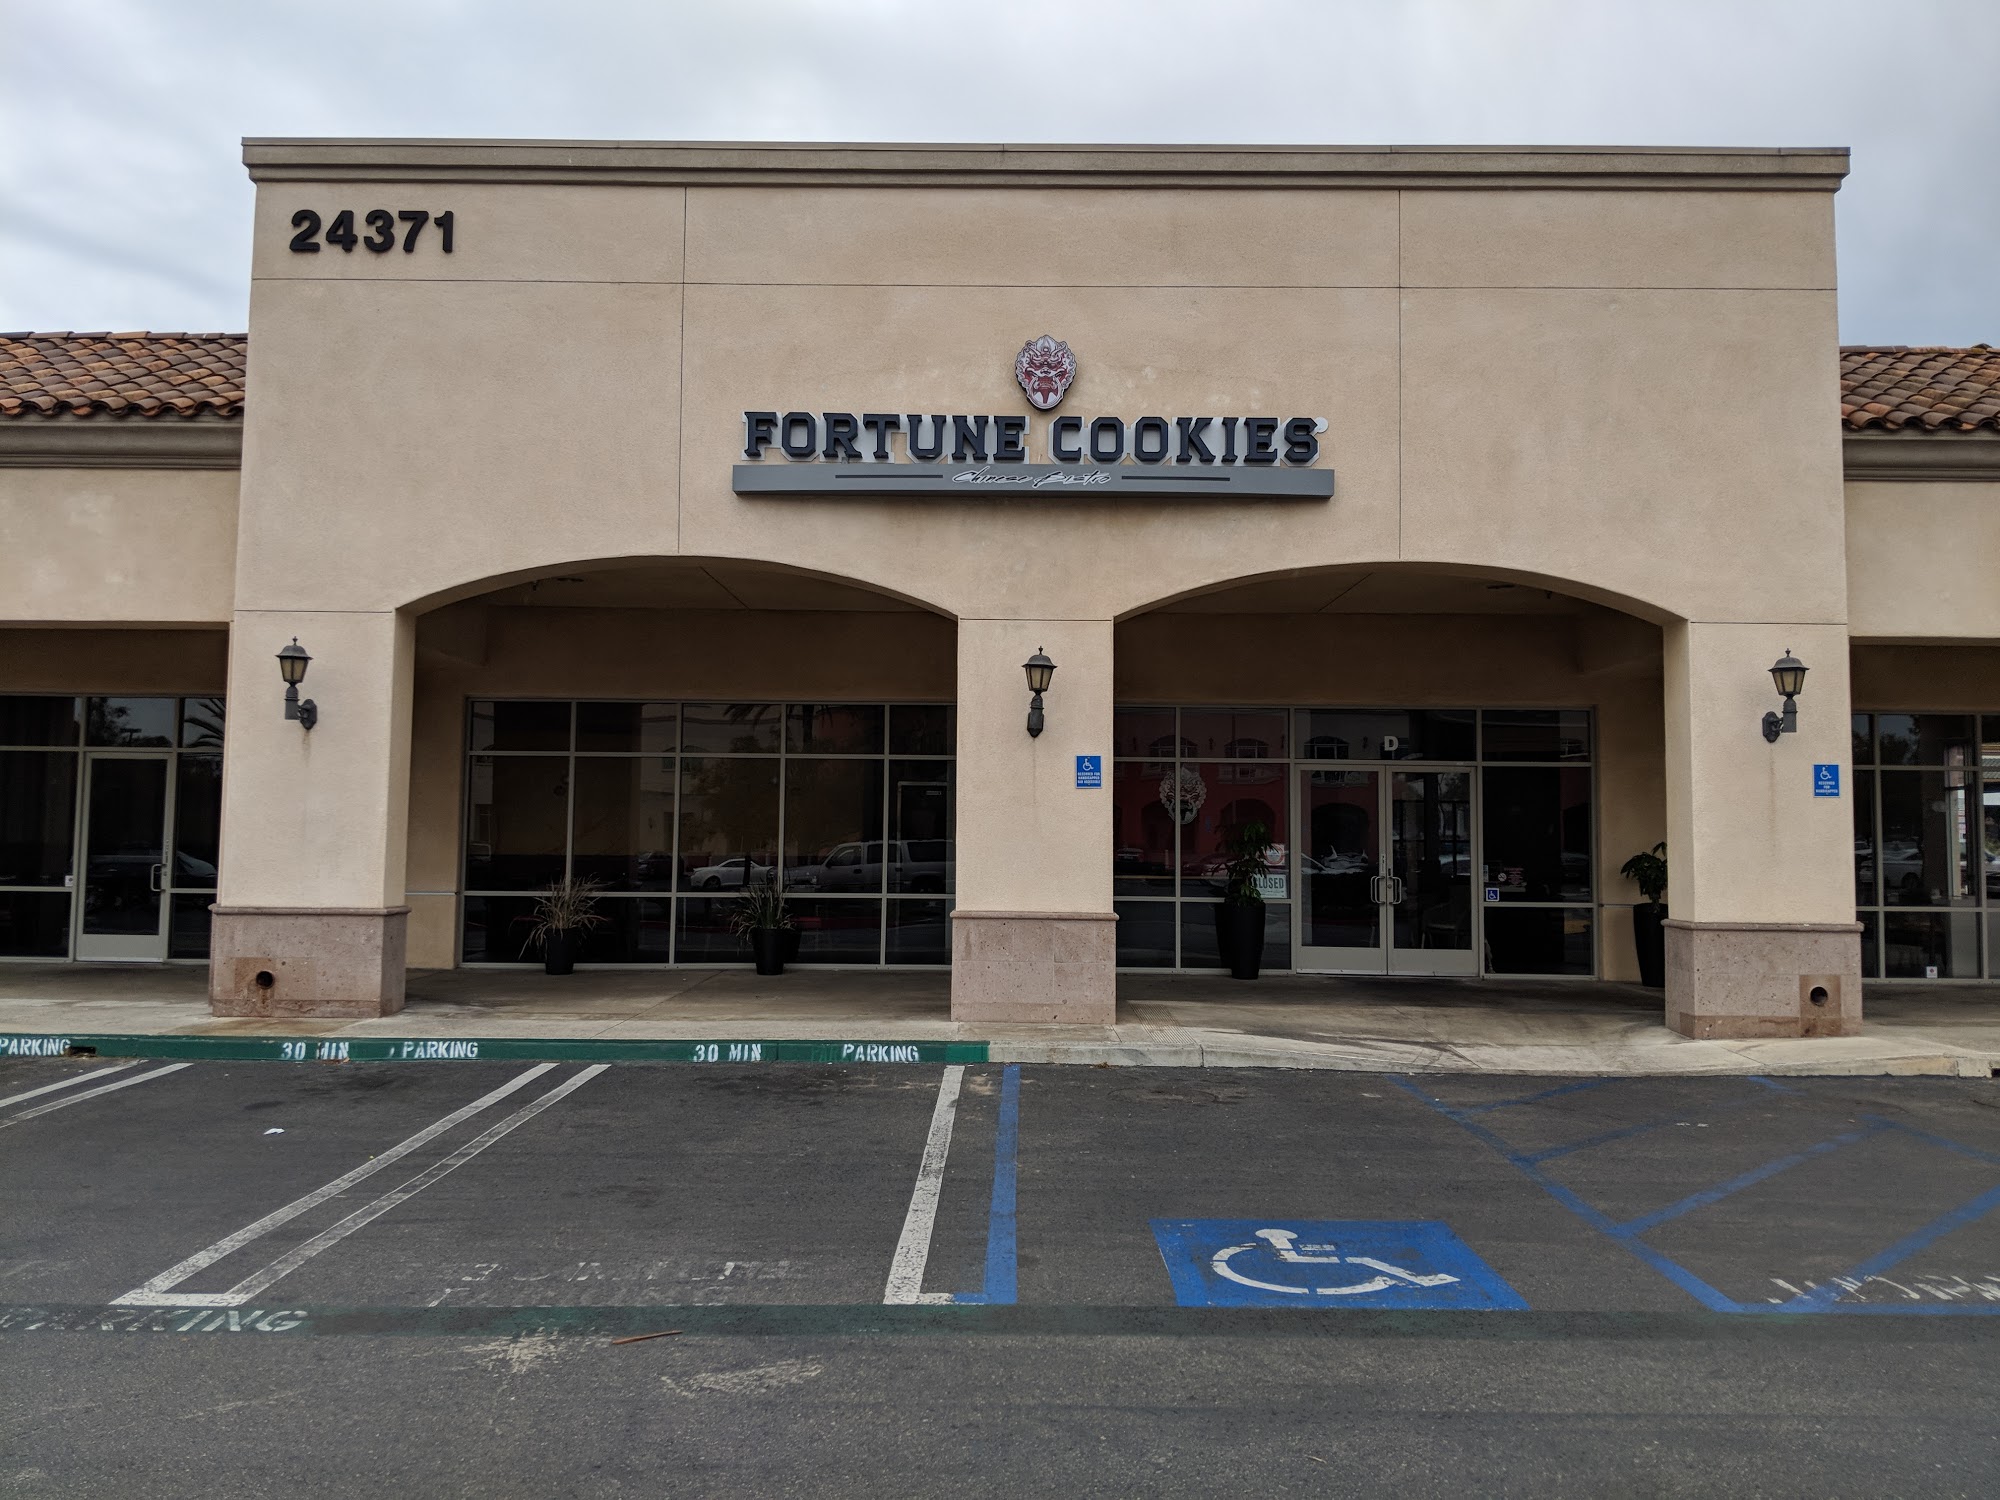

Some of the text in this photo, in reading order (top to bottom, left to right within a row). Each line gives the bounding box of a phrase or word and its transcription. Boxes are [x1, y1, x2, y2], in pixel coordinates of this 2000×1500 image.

[289, 209, 454, 253] 24371
[743, 411, 1320, 464] FORTUNE COOKIES
[1384, 735, 1399, 751] D
[281, 1041, 306, 1060] 30
[402, 1041, 478, 1059] PARKING
[693, 1044, 762, 1063] 30 MIN
[842, 1044, 920, 1063] PARKING
[0, 1308, 309, 1332] RKING
